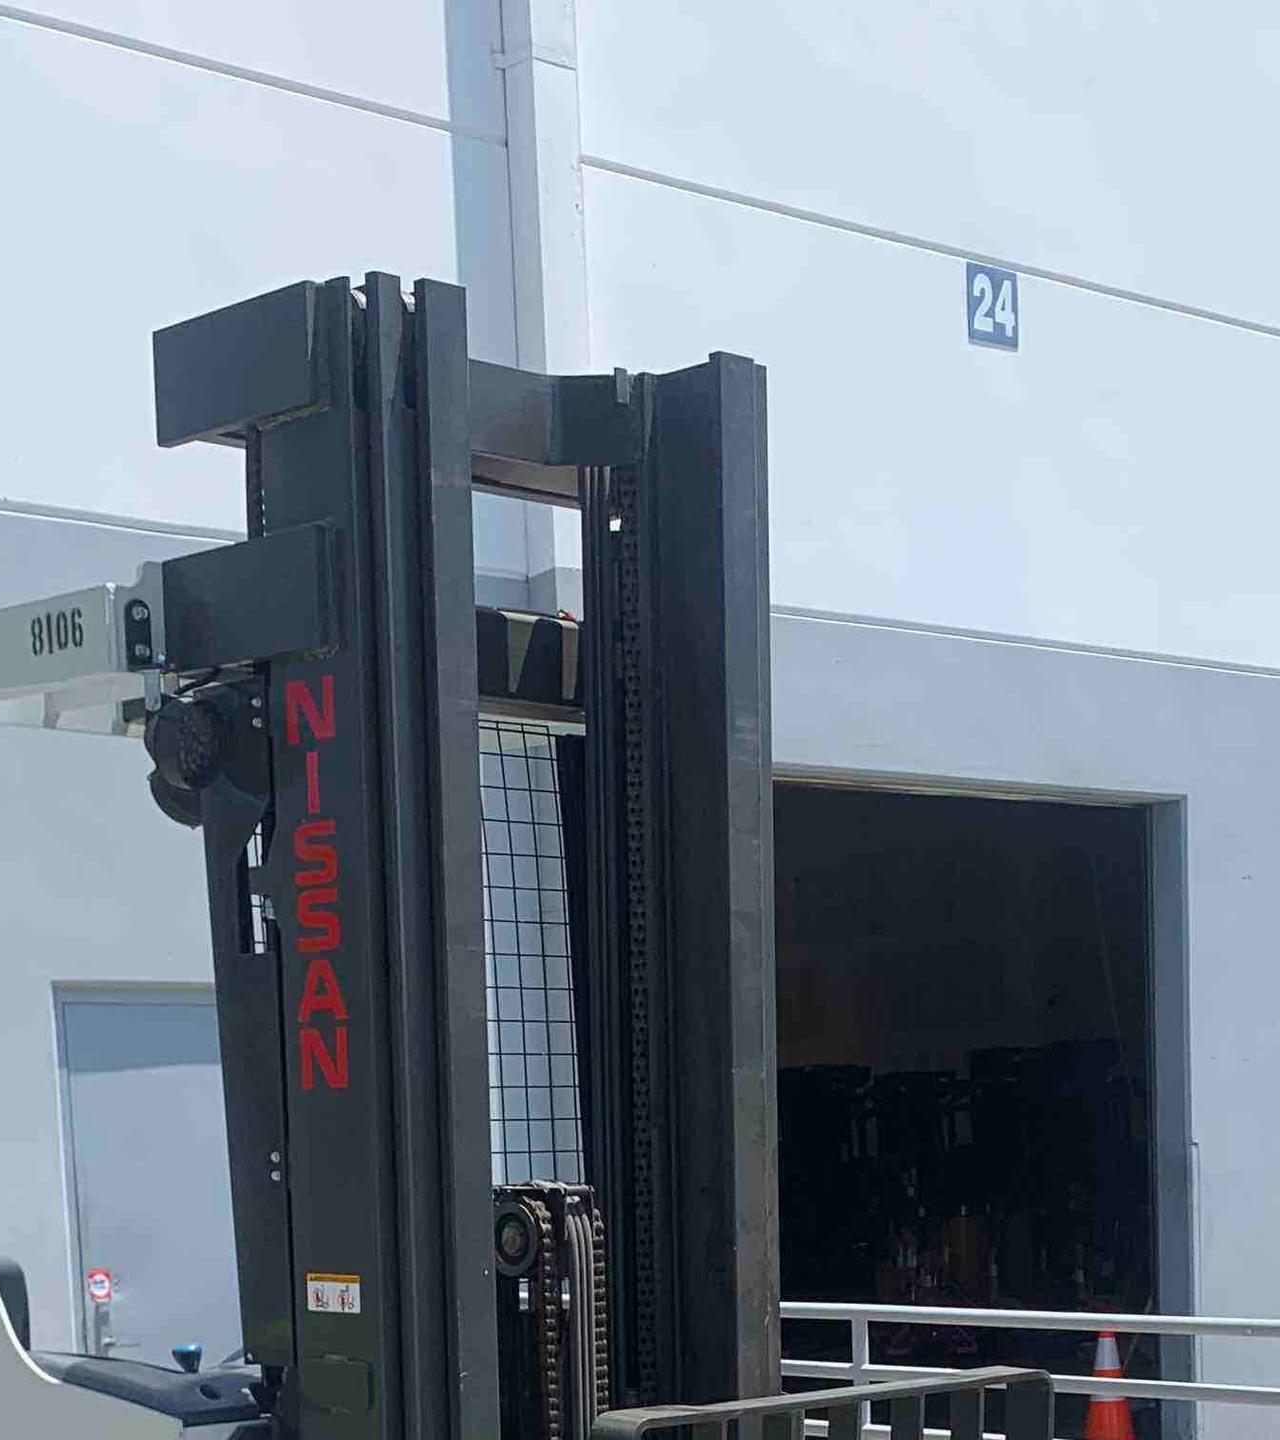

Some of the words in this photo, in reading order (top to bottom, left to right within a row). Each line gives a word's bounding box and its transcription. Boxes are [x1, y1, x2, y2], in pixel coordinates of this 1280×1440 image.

[973, 273, 1015, 337] 24
[31, 607, 84, 656] 8106
[284, 675, 349, 1090] NISSAN
